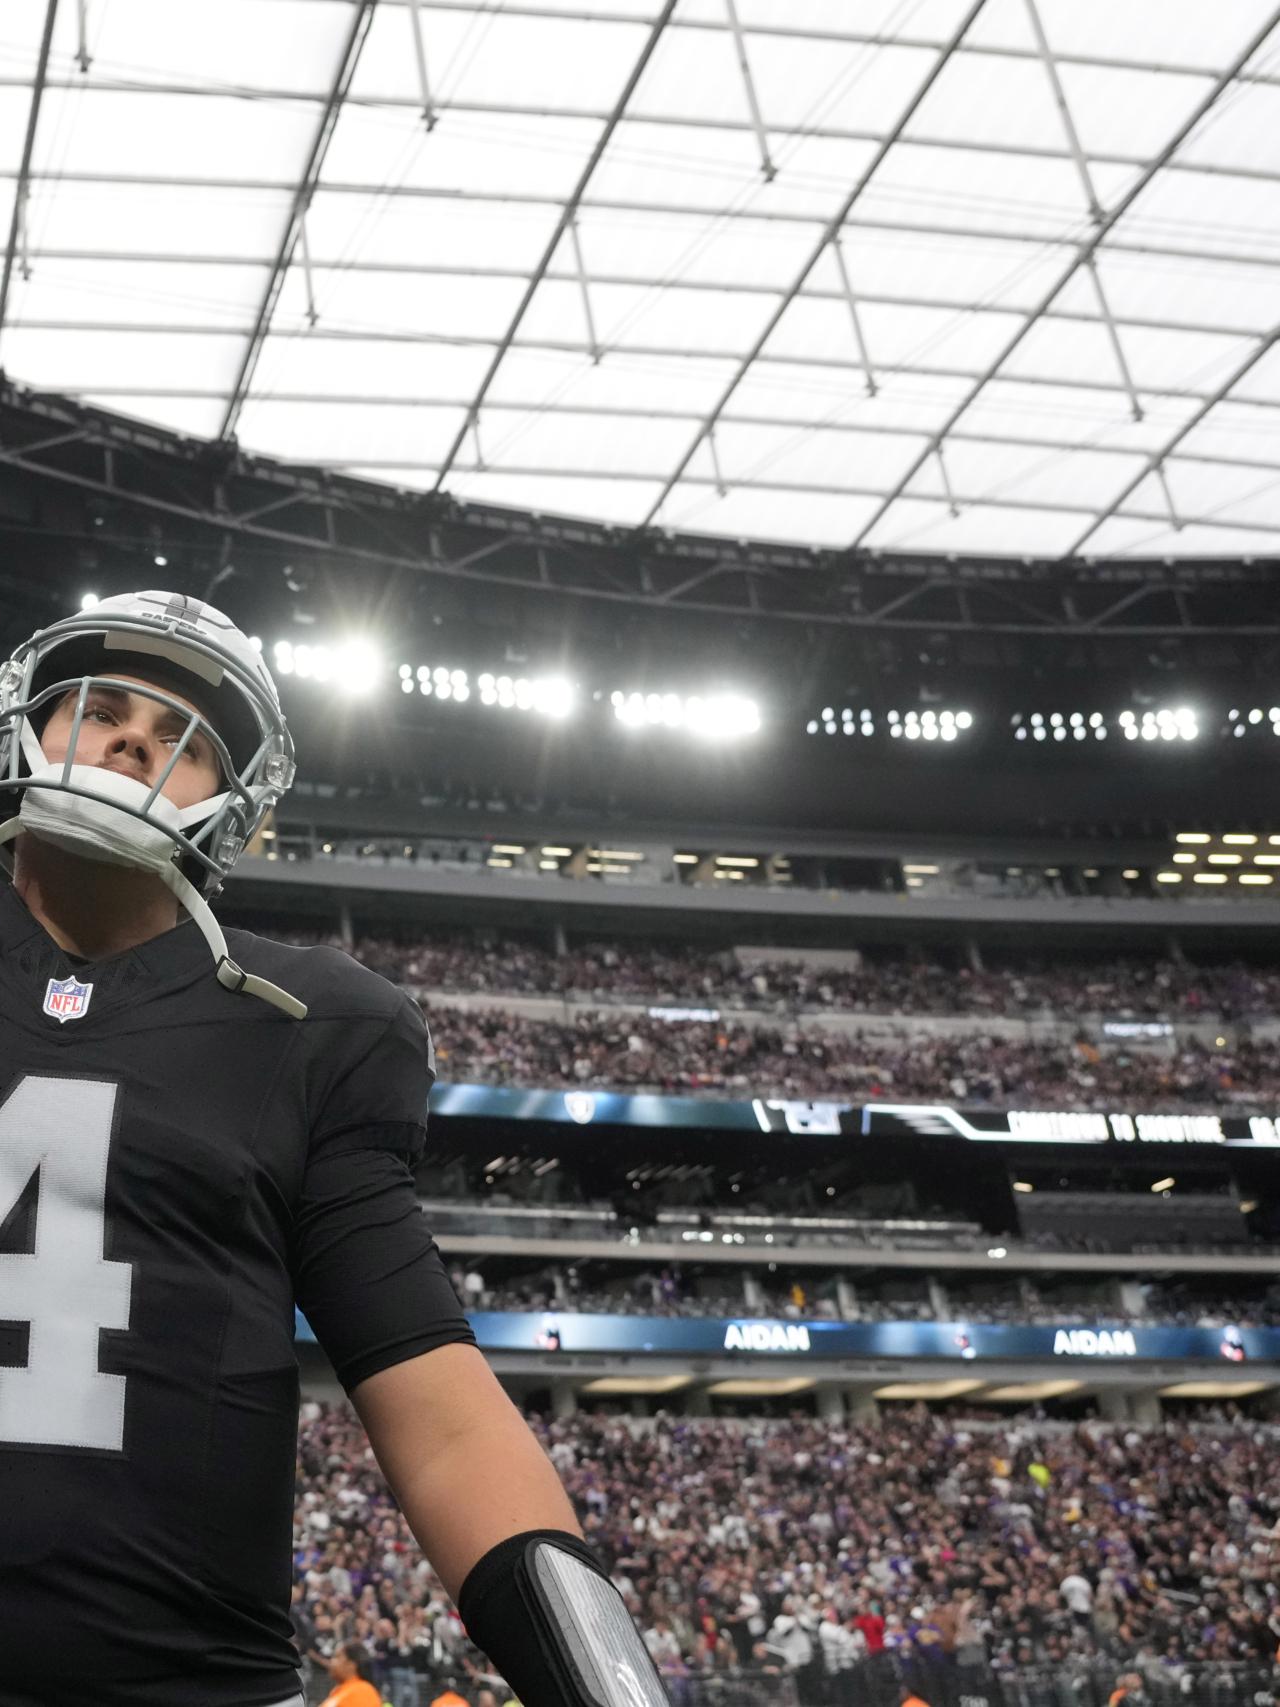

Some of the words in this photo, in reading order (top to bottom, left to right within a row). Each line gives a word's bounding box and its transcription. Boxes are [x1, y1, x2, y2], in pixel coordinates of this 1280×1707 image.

[50, 994, 81, 1013] NFL
[724, 1324, 810, 1351] AIDAN
[1053, 1329, 1136, 1355] AIDAN
